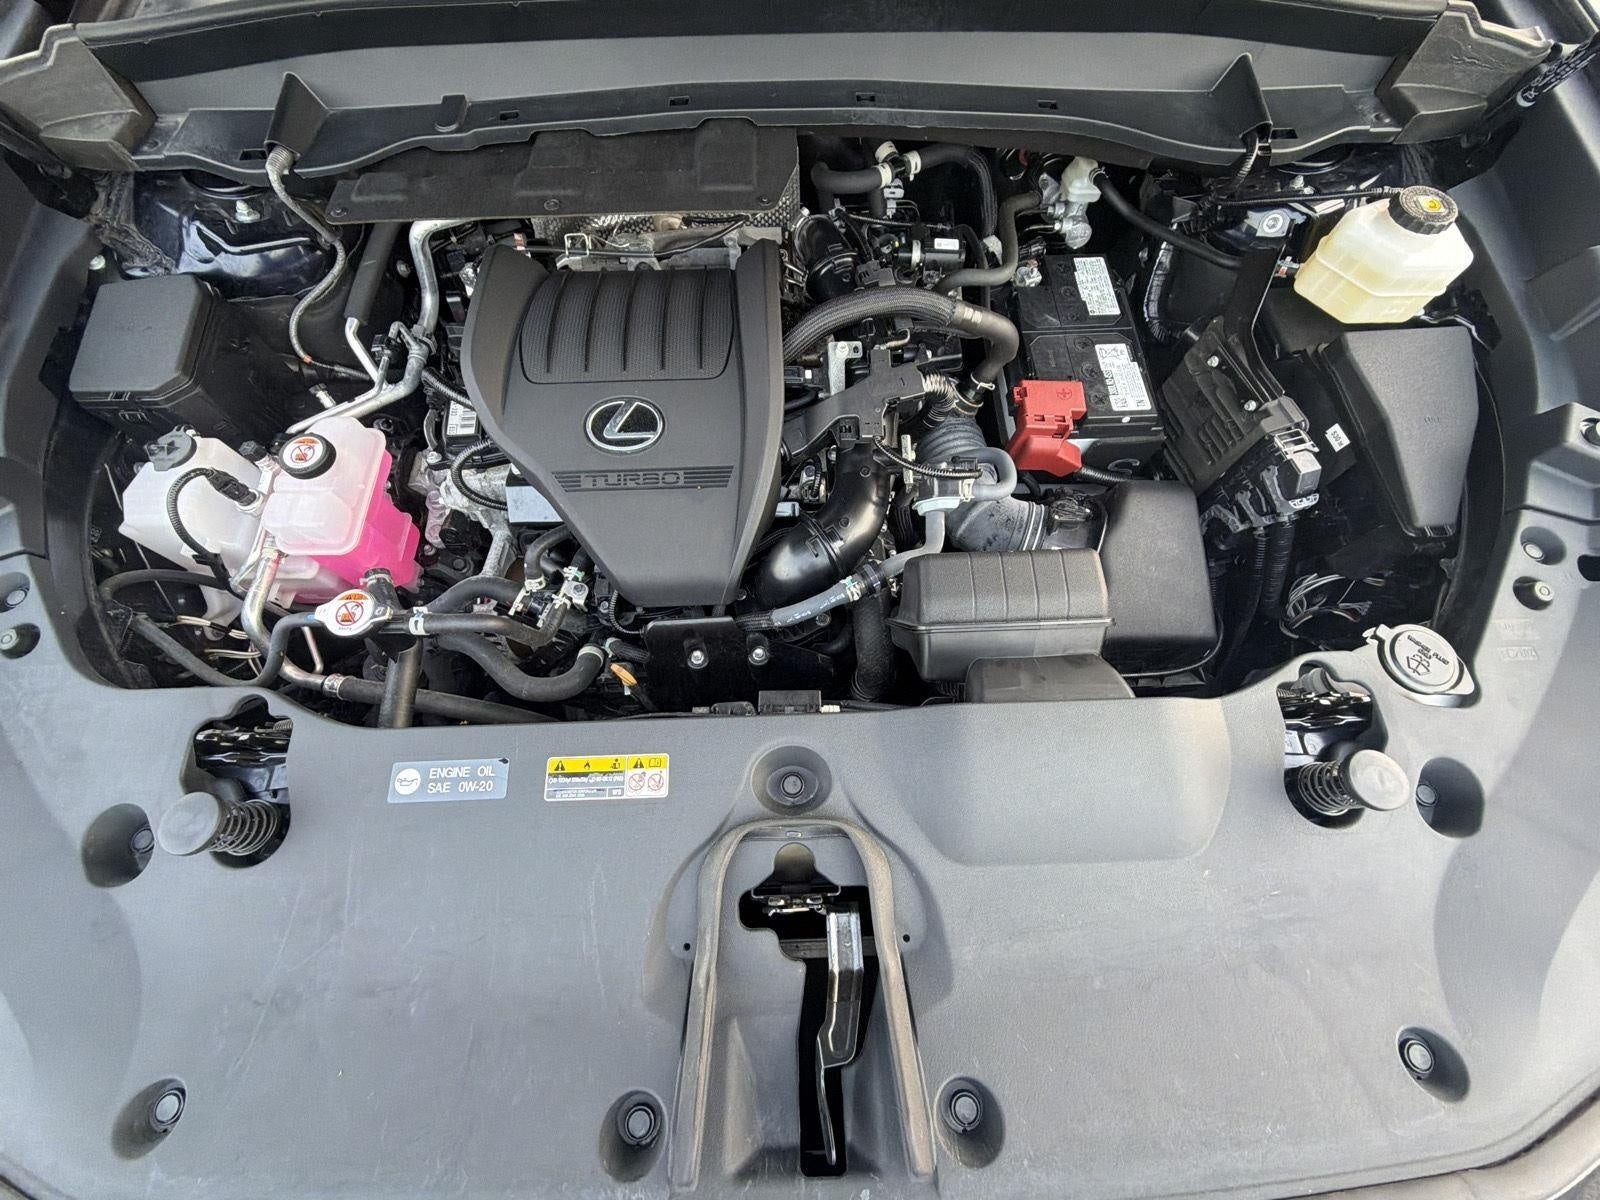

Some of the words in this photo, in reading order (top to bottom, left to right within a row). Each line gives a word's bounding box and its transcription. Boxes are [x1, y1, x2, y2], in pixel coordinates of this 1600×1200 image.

[584, 471, 681, 487] TURBO
[428, 766, 471, 779] ENGINE
[477, 765, 496, 777] OIL
[427, 782, 451, 794] SAE
[458, 780, 494, 793] 0W-20
